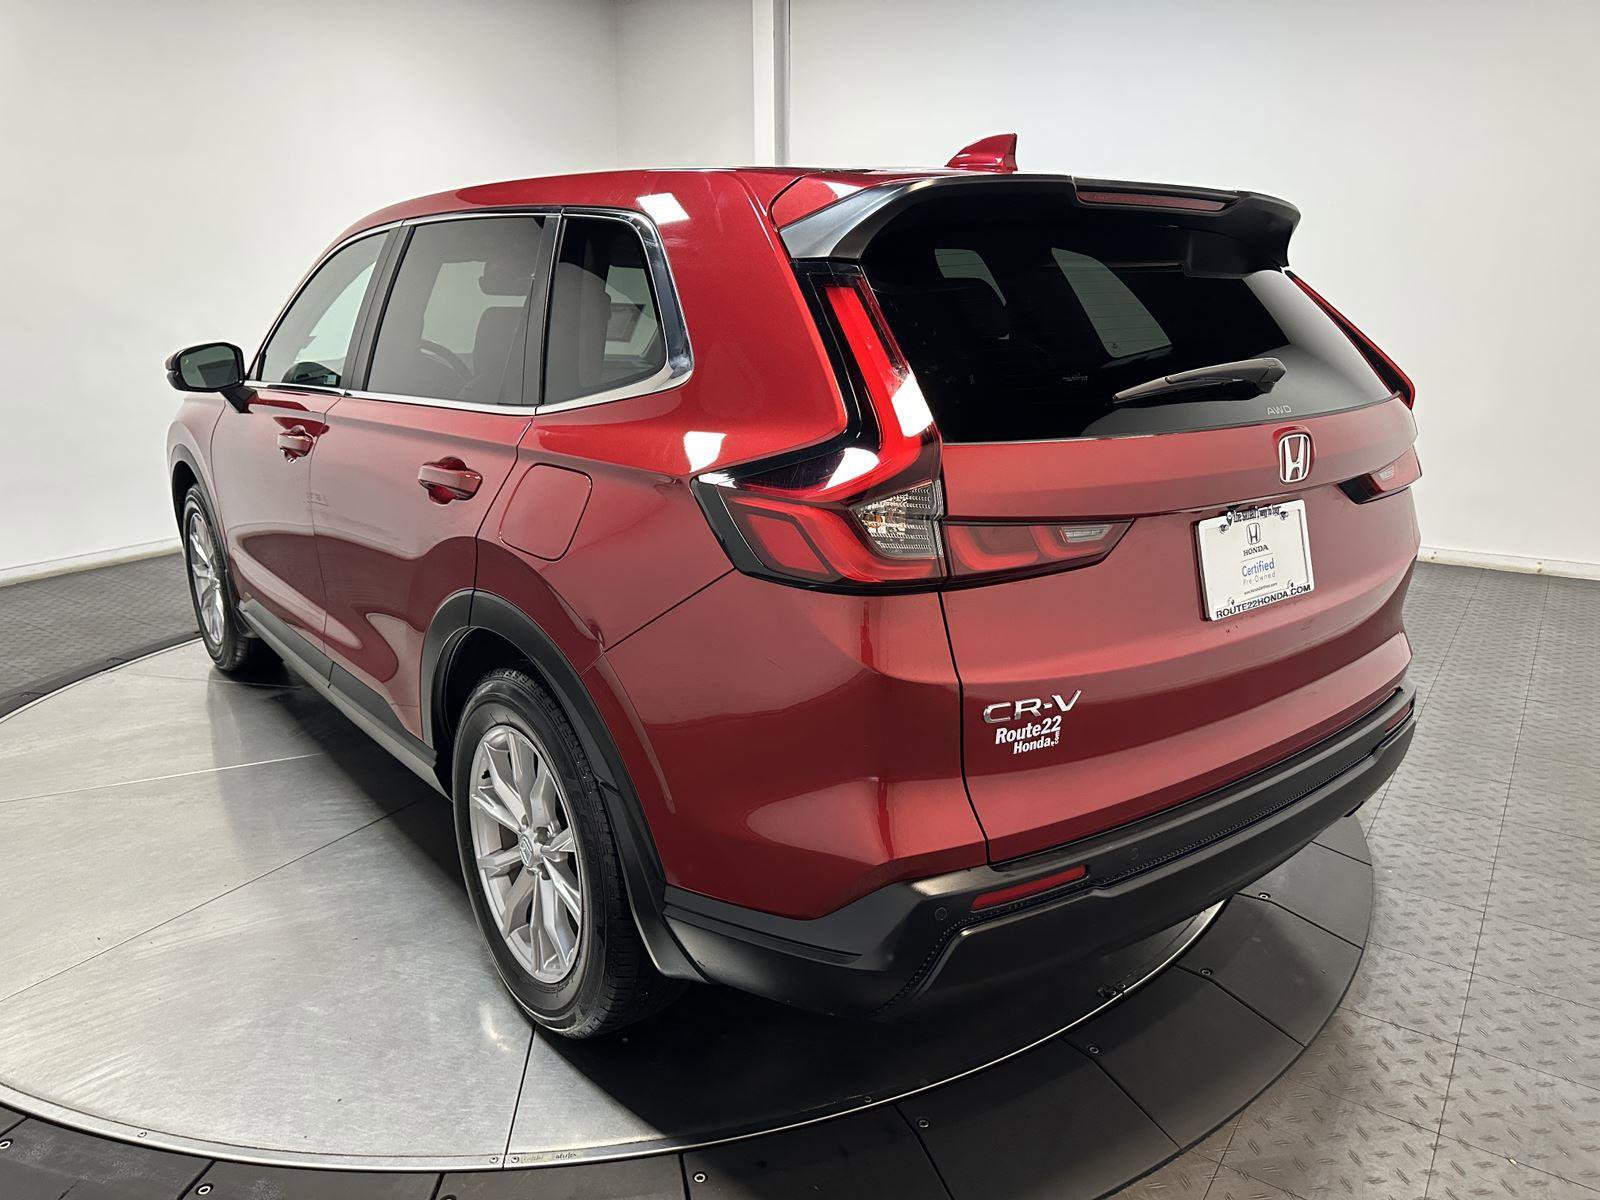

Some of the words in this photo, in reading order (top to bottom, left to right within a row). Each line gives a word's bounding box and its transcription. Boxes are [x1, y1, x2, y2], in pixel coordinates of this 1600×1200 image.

[1267, 405, 1292, 415] AWD
[1243, 544, 1269, 556] HONDA
[1242, 558, 1275, 577] Certified
[1216, 584, 1311, 618] ROUTE22HONDA.COM
[983, 689, 1082, 723] CR-V
[995, 715, 1062, 744] Route22
